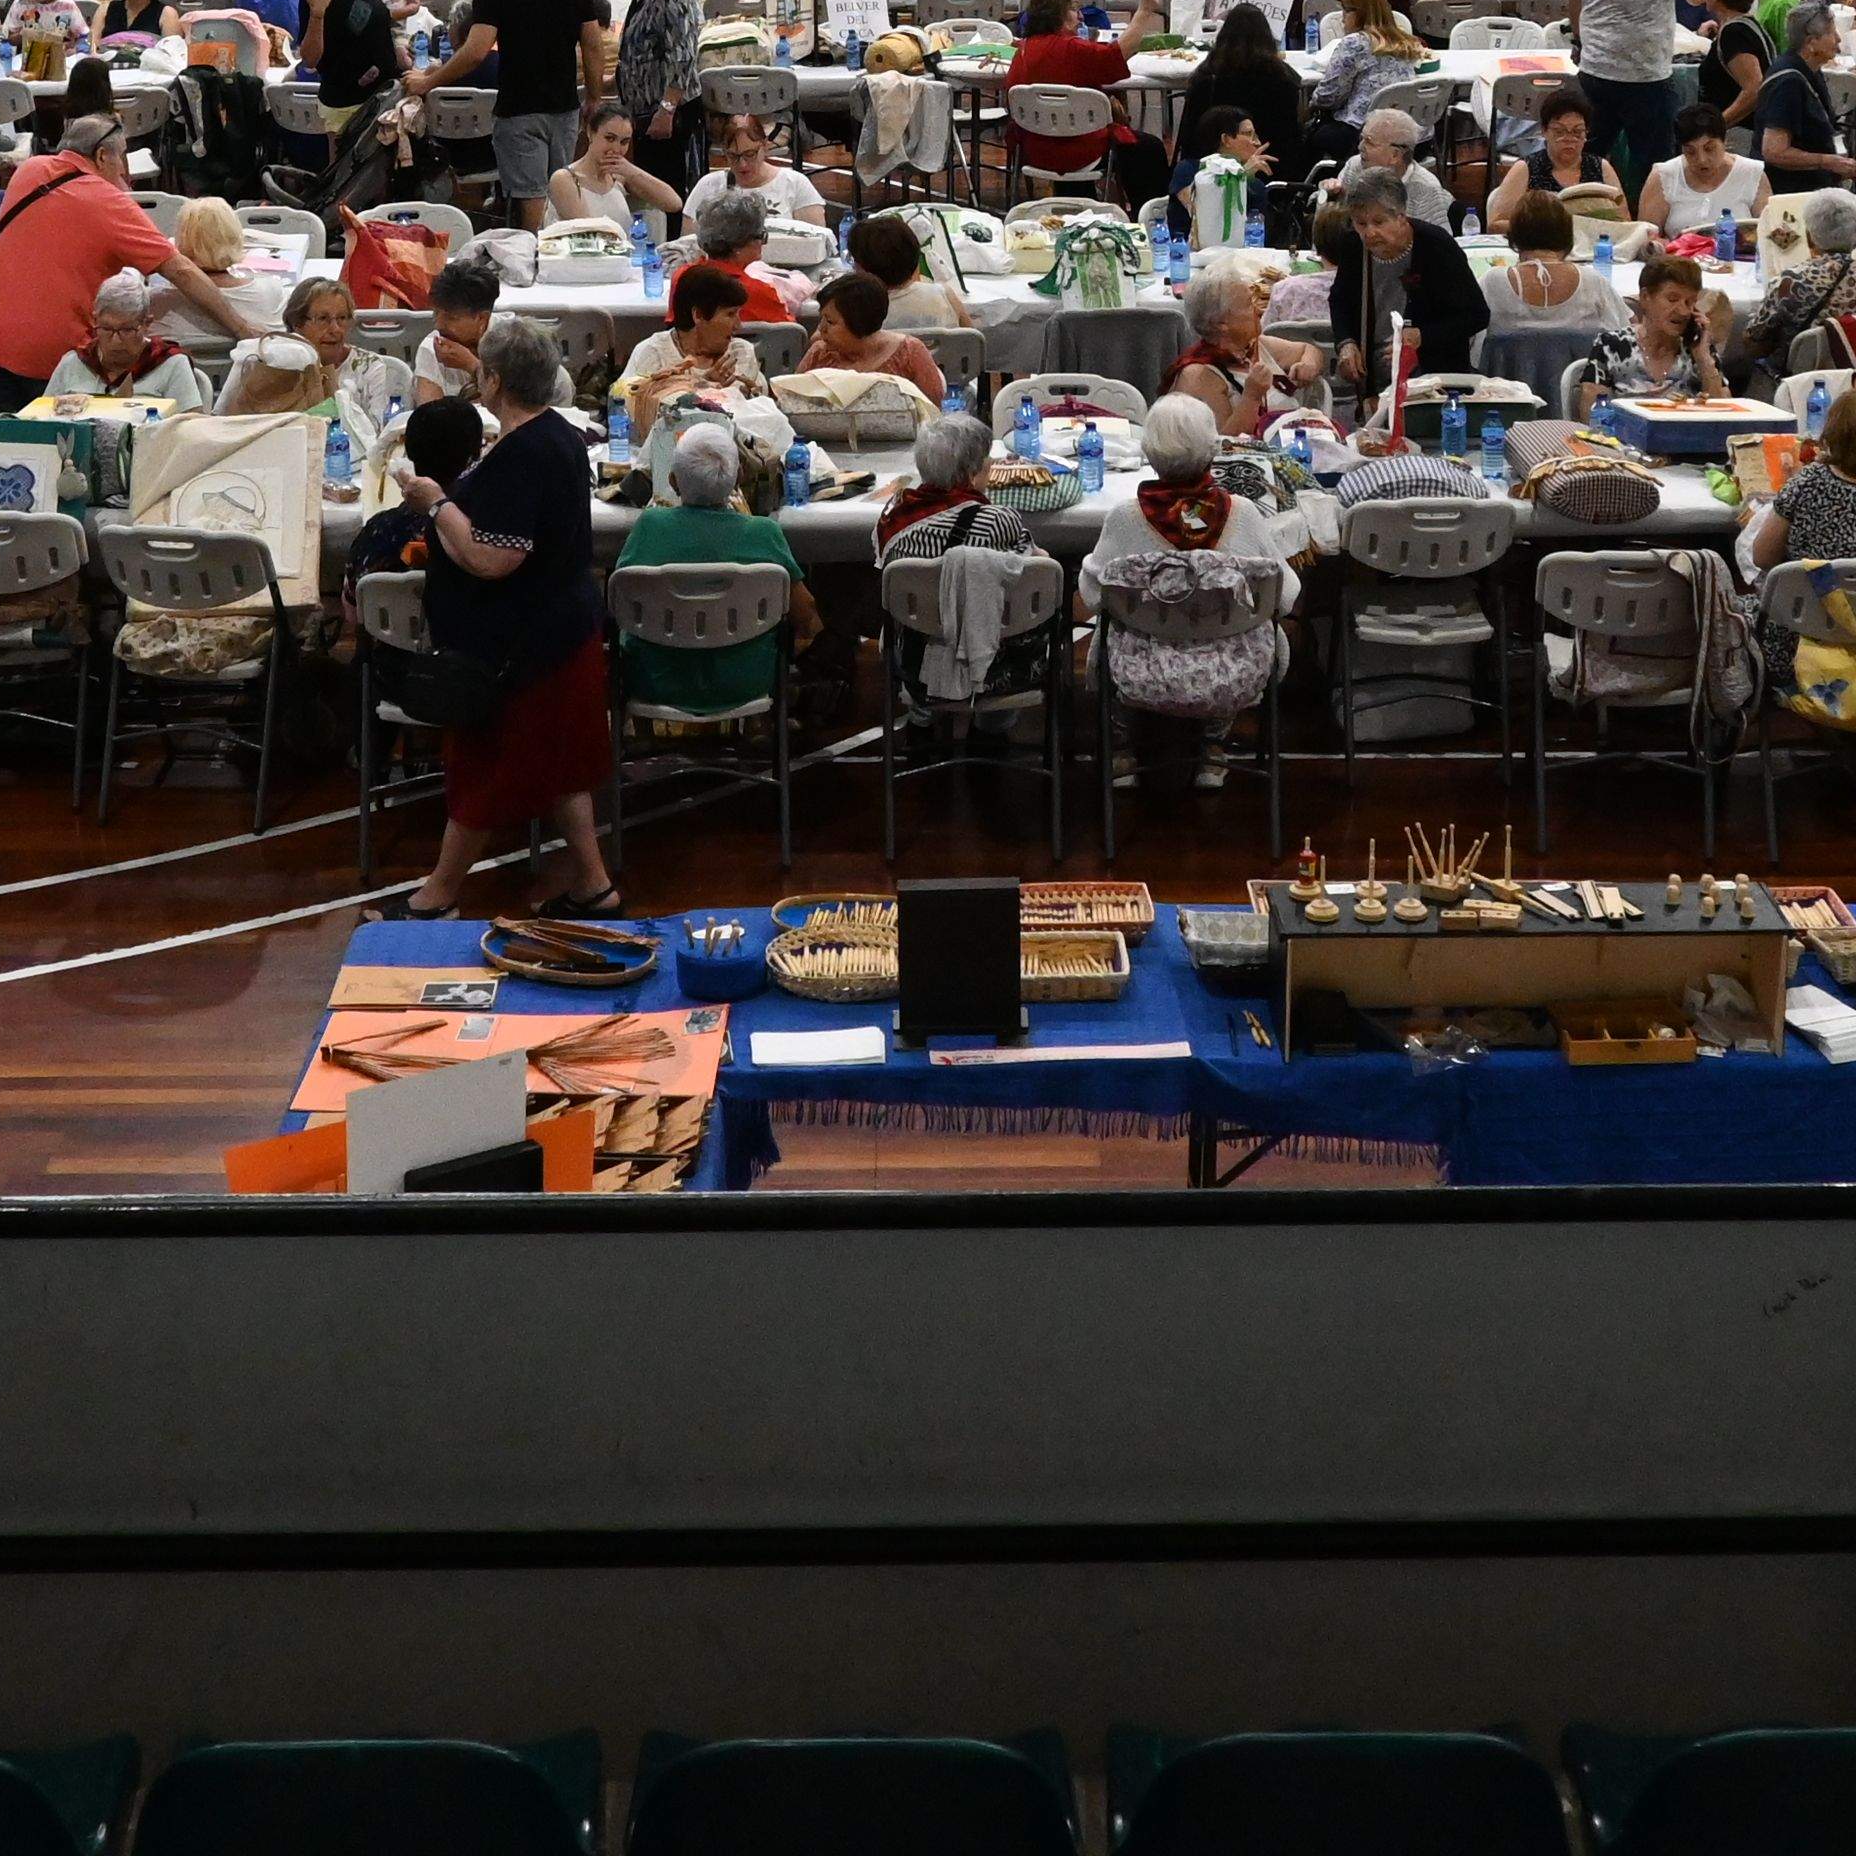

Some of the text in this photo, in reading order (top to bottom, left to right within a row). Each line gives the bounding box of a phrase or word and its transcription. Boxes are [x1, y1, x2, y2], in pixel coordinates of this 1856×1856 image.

[836, 1, 880, 13] BELVER
[847, 15, 869, 25] DEL
[839, 29, 875, 39] CCA
